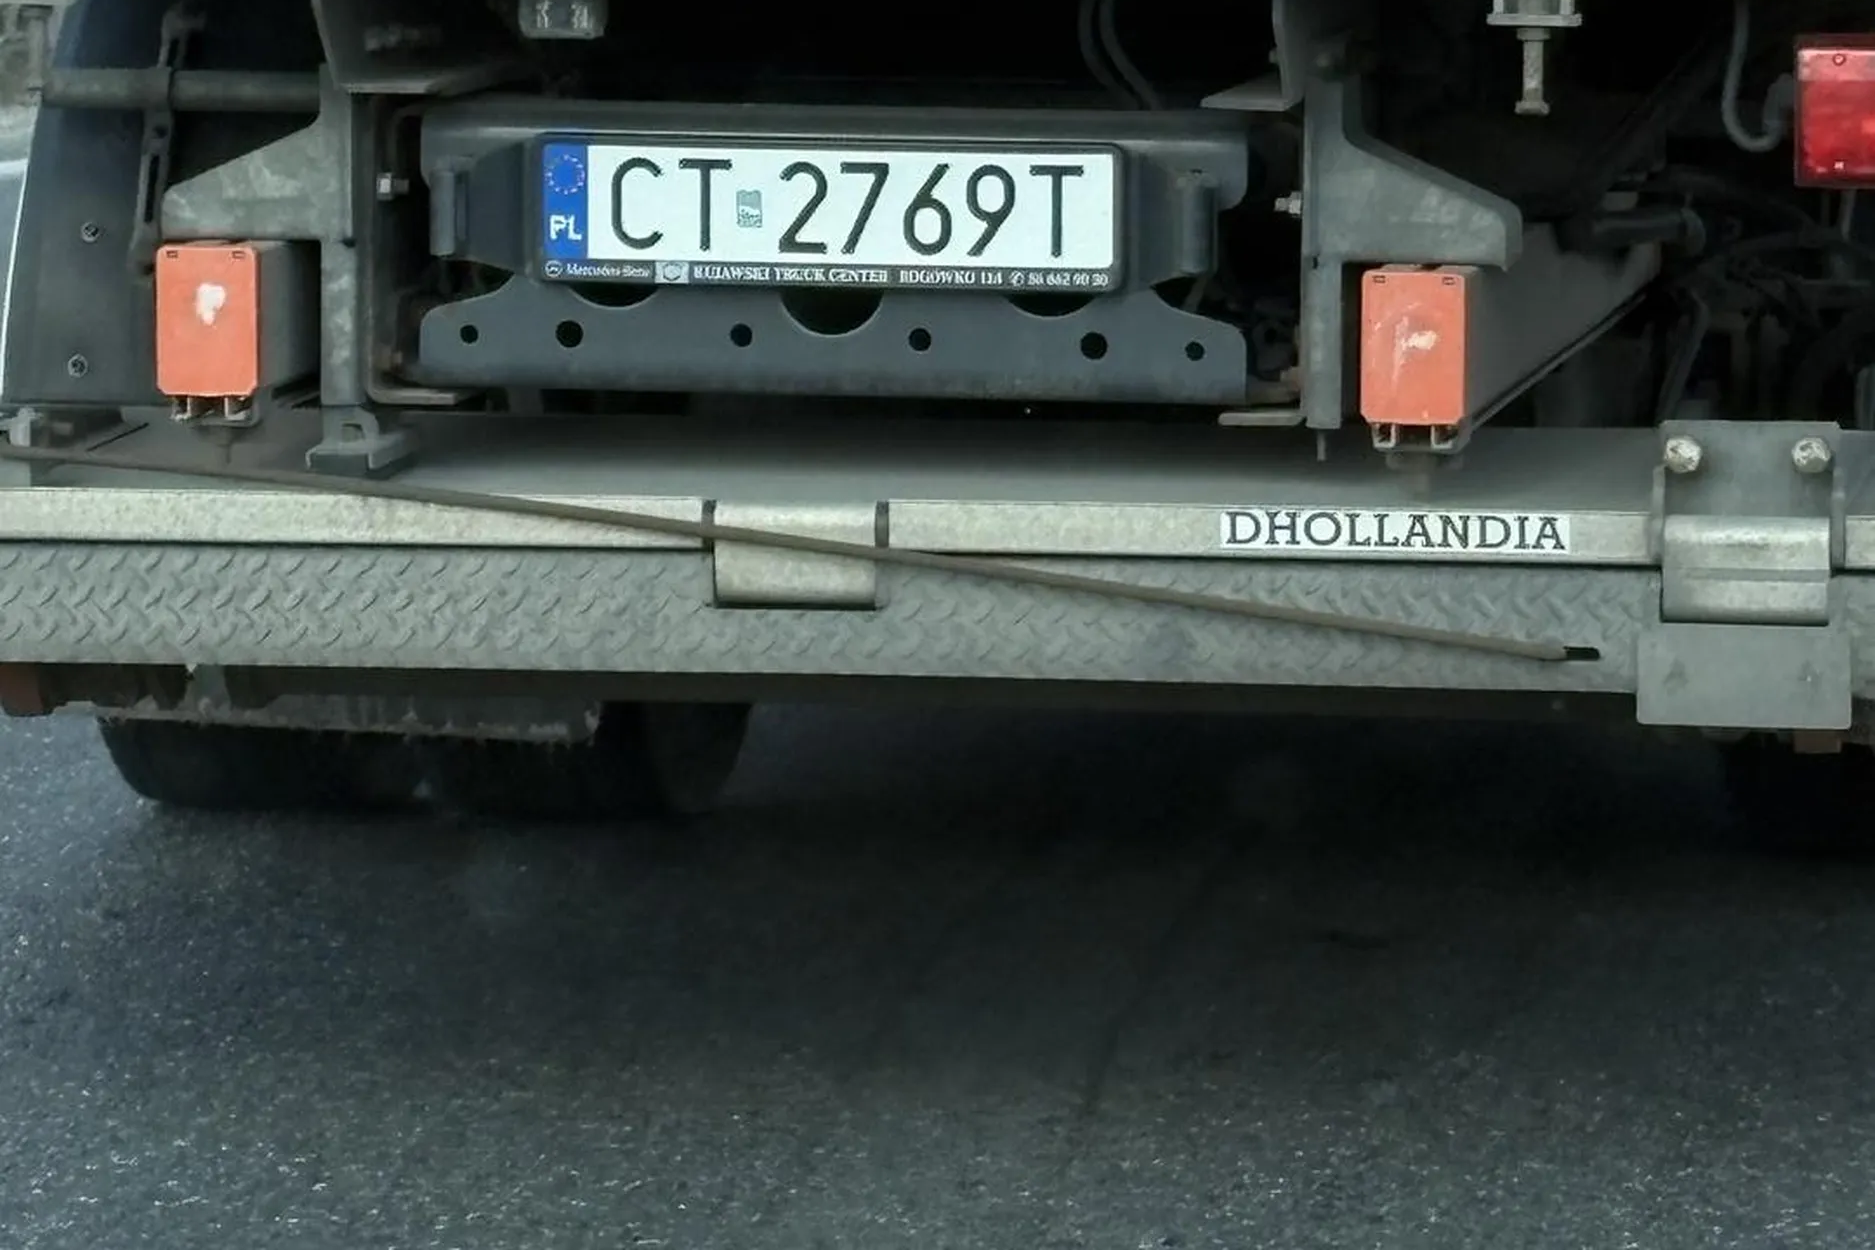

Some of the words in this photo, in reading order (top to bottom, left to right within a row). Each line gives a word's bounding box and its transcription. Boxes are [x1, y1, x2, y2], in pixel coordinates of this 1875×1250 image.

[610, 157, 733, 251] CT
[779, 161, 1084, 258] 2769T
[550, 215, 582, 240] PL
[828, 268, 888, 283] CENTER
[1225, 510, 1567, 550] DHOLLANDIA
